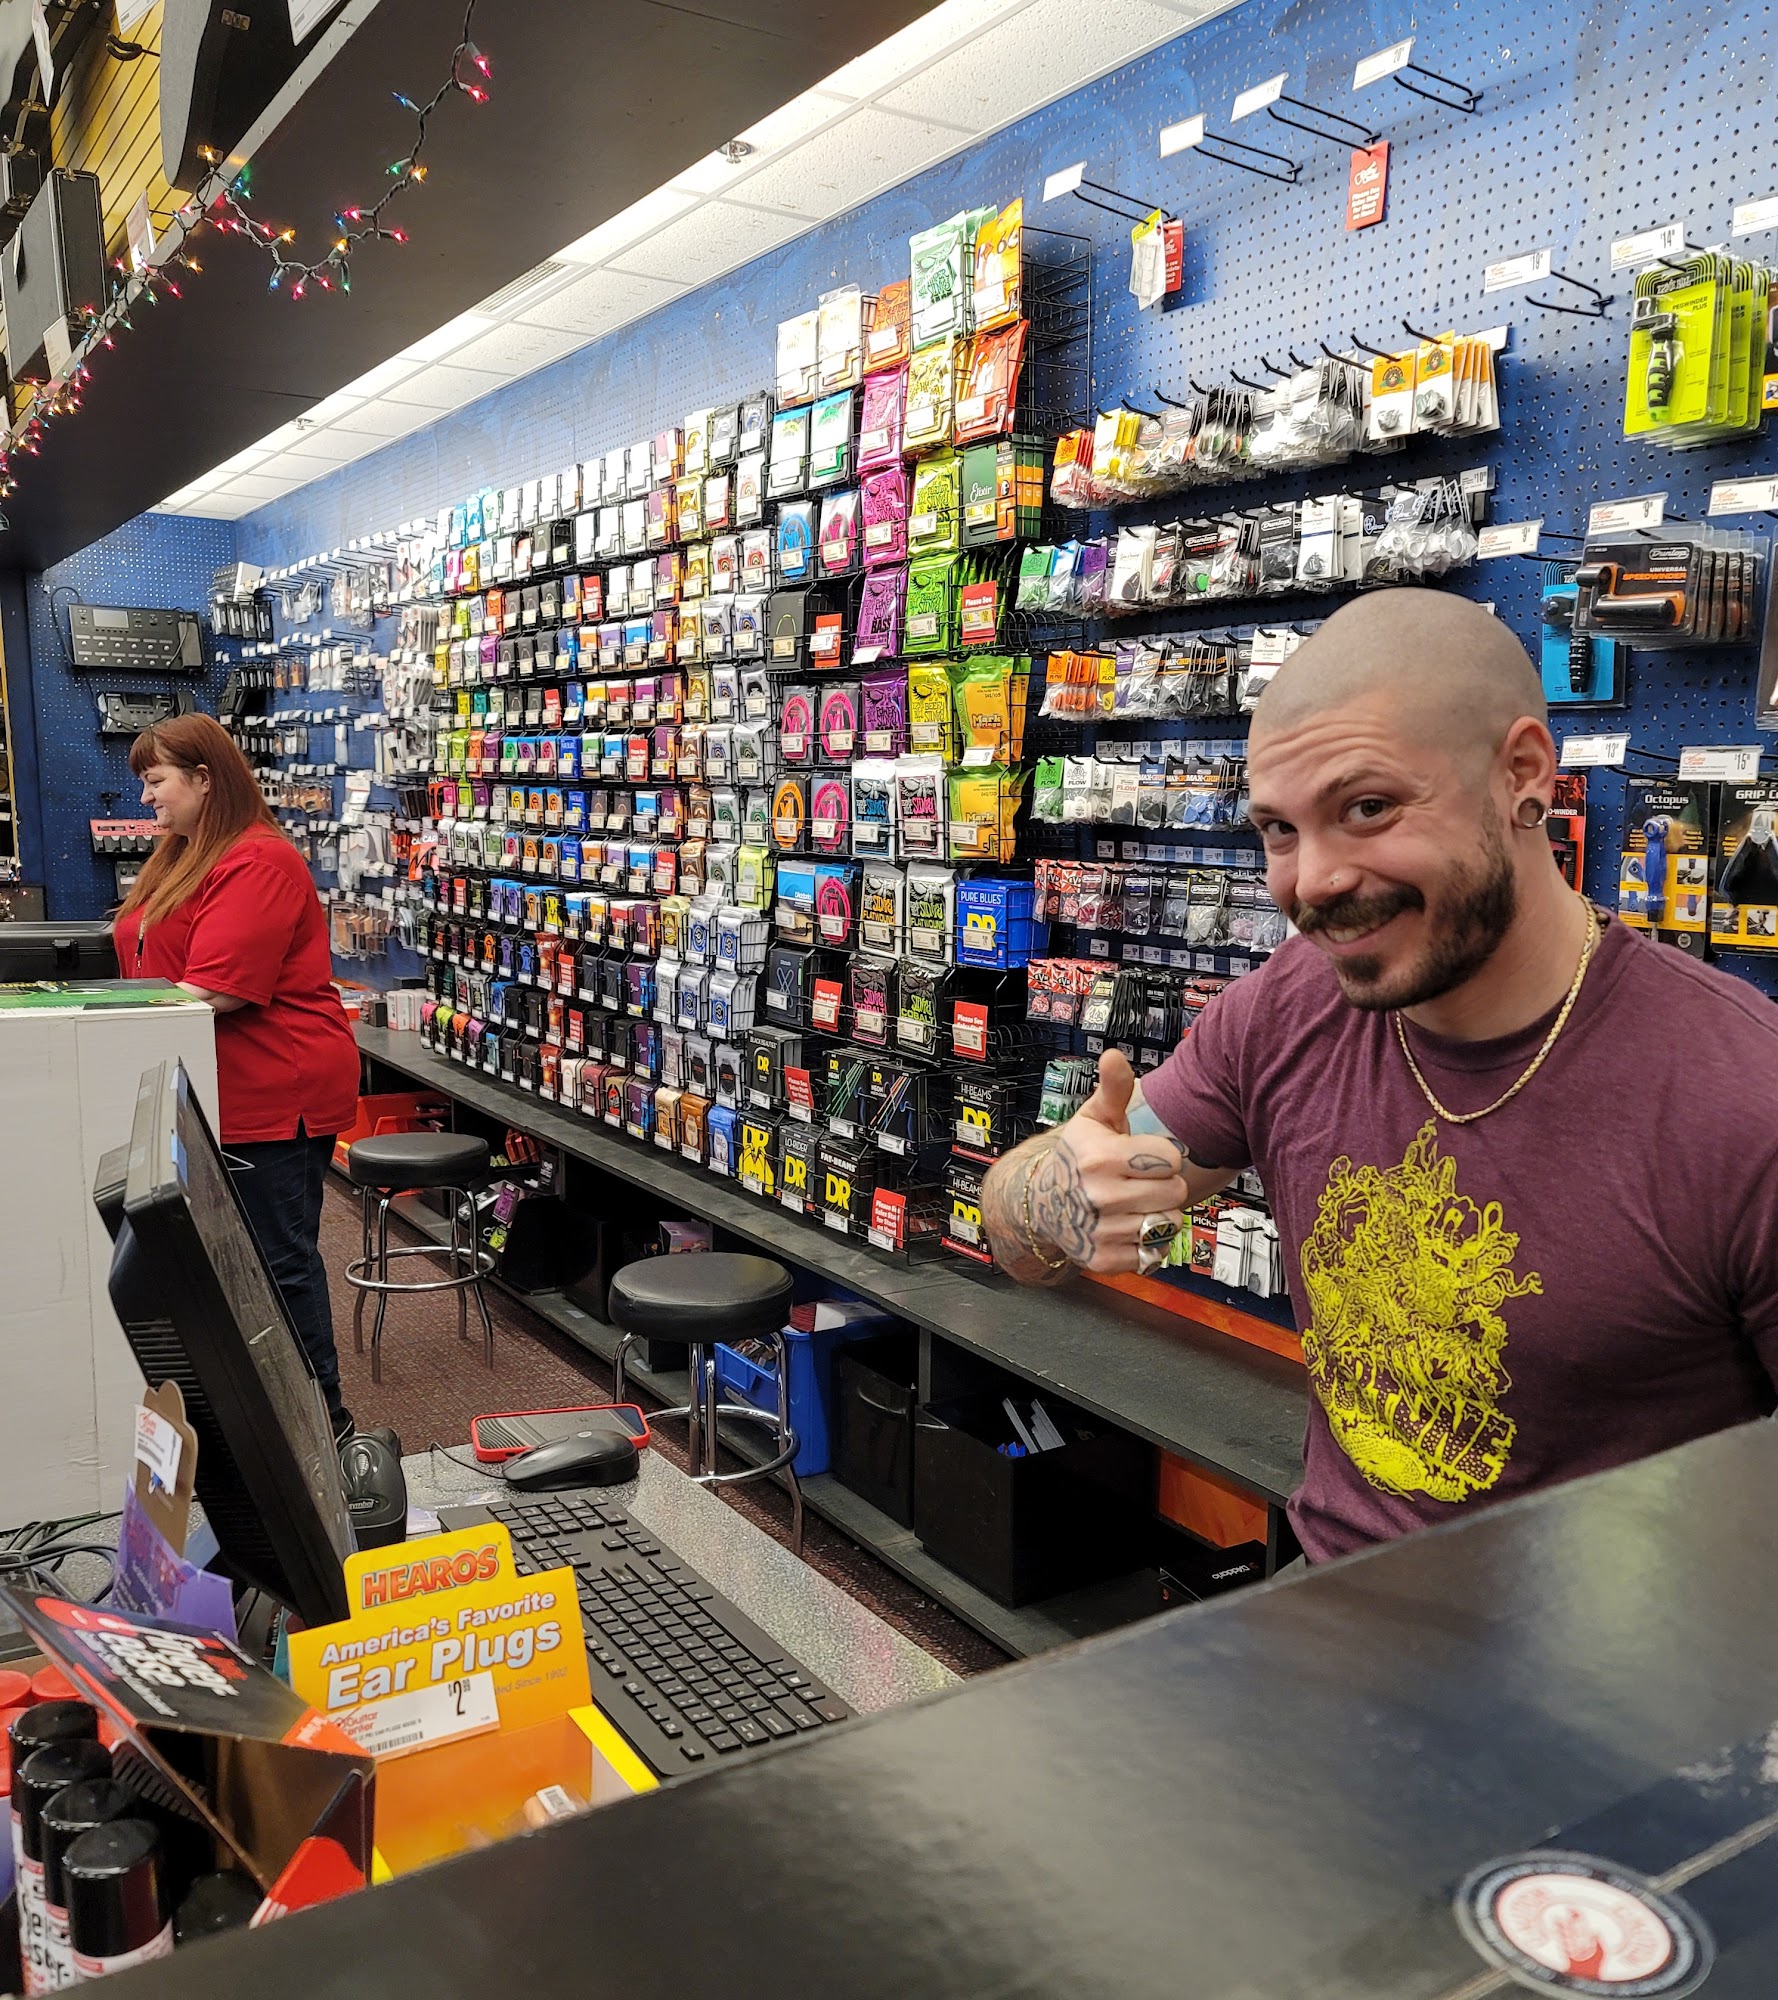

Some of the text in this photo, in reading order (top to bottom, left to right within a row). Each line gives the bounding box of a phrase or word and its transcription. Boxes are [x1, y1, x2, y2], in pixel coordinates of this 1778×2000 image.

[1672, 296, 1708, 310] PEGWINDER
[1692, 302, 1708, 312] PLUS
[970, 482, 992, 502] Elixir
[1186, 534, 1217, 547] Dunlop
[1651, 549, 1688, 559] Dunlop
[1622, 573, 1687, 581] SPEEDWINDER
[965, 596, 993, 607] Please See
[871, 618, 892, 634] BASS
[972, 713, 1002, 724] Mark
[1116, 783, 1137, 792] FLOW
[1736, 789, 1778, 799] GRIP C
[1645, 794, 1689, 806] Octopus
[1190, 884, 1220, 895] Dunlop
[961, 891, 1002, 905] PURE BLUES
[816, 989, 839, 1001] Please See
[901, 1007, 934, 1024] COBALT
[957, 1013, 984, 1026] Please See
[757, 1054, 769, 1073] DR
[829, 1059, 839, 1071] DR
[872, 1071, 882, 1085] DR
[961, 1083, 992, 1100] HI-BEAMS
[962, 1106, 991, 1144] DR
[742, 1124, 769, 1156] DR
[784, 1137, 808, 1154] LO-RIDER
[820, 1151, 858, 1173] FAT-BEAMS
[784, 1154, 807, 1190] DR
[825, 1172, 851, 1211] DR
[953, 1177, 983, 1197] HI-BEAMS
[875, 1199, 888, 1210] Please
[875, 1208, 887, 1218] Sales
[883, 1218, 896, 1228] Stock
[1193, 1216, 1217, 1228] PICKS
[362, 1545, 499, 1610] HEAROS
[1211, 1564, 1250, 1579] D'Addario
[320, 1592, 556, 1668] America's Favorite
[326, 1620, 562, 1711] Ear Plugs
[515, 1673, 542, 1691] Since
